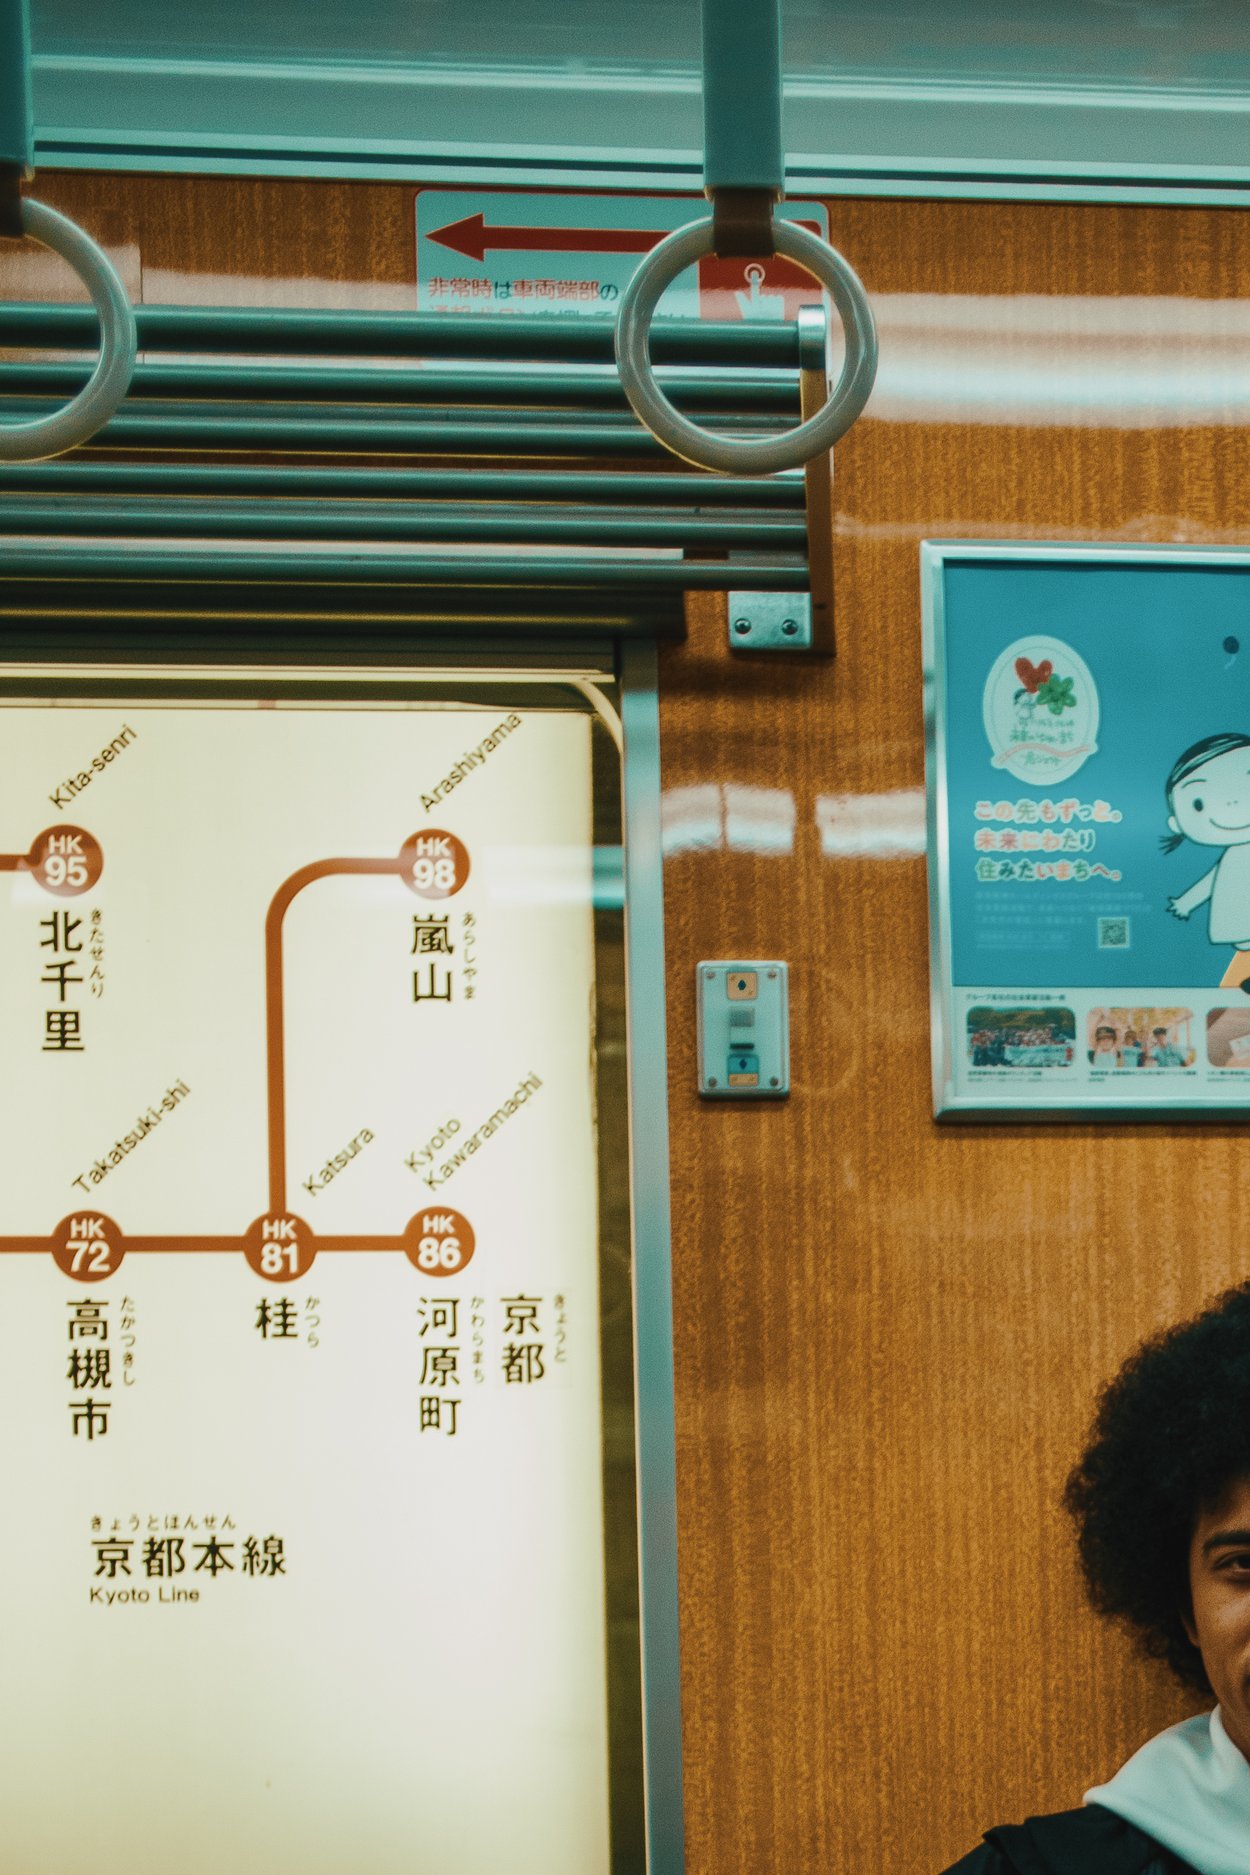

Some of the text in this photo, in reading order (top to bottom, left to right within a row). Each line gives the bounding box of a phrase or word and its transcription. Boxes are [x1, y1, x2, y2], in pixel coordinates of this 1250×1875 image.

[428, 277, 619, 301] 非常時は車両端部の
[48, 723, 138, 810] Kita-senri
[419, 713, 523, 813] Arashiyama
[976, 799, 1122, 823] この先もずっと。
[48, 836, 83, 854] HK
[416, 838, 451, 858] HK
[976, 828, 1096, 851] 未来にわたり
[44, 855, 89, 887] 95
[412, 857, 457, 890] 98
[977, 857, 1122, 881] 住みたいまちへ。
[90, 909, 104, 997] きたせんり
[410, 912, 455, 1003] 嵐山
[463, 912, 477, 1000] あらしやま
[40, 911, 85, 1051] 北千里
[71, 1077, 192, 1193] Takatsuki-shi
[403, 1117, 463, 1170] Kyoto
[424, 1072, 544, 1191] Kawaramachi
[302, 1129, 375, 1197] Katsura
[71, 1219, 104, 1238] HK
[263, 1220, 296, 1239] HK
[423, 1216, 454, 1233] HK
[66, 1241, 110, 1271] 72
[260, 1242, 299, 1274] 81
[418, 1237, 461, 1268] 86
[255, 1298, 298, 1339] 桂
[305, 1296, 321, 1348] かつら
[471, 1296, 485, 1382] かわらまち
[503, 1294, 545, 1383] 京都
[554, 1294, 566, 1362] きょうと
[121, 1296, 136, 1386] たかつきし
[67, 1298, 112, 1440] 高槻市
[418, 1298, 461, 1436] 河原町
[91, 1515, 235, 1531] きょうとほんせん
[92, 1535, 286, 1578] 京都本線
[90, 1587, 200, 1605] Kyoto Line
